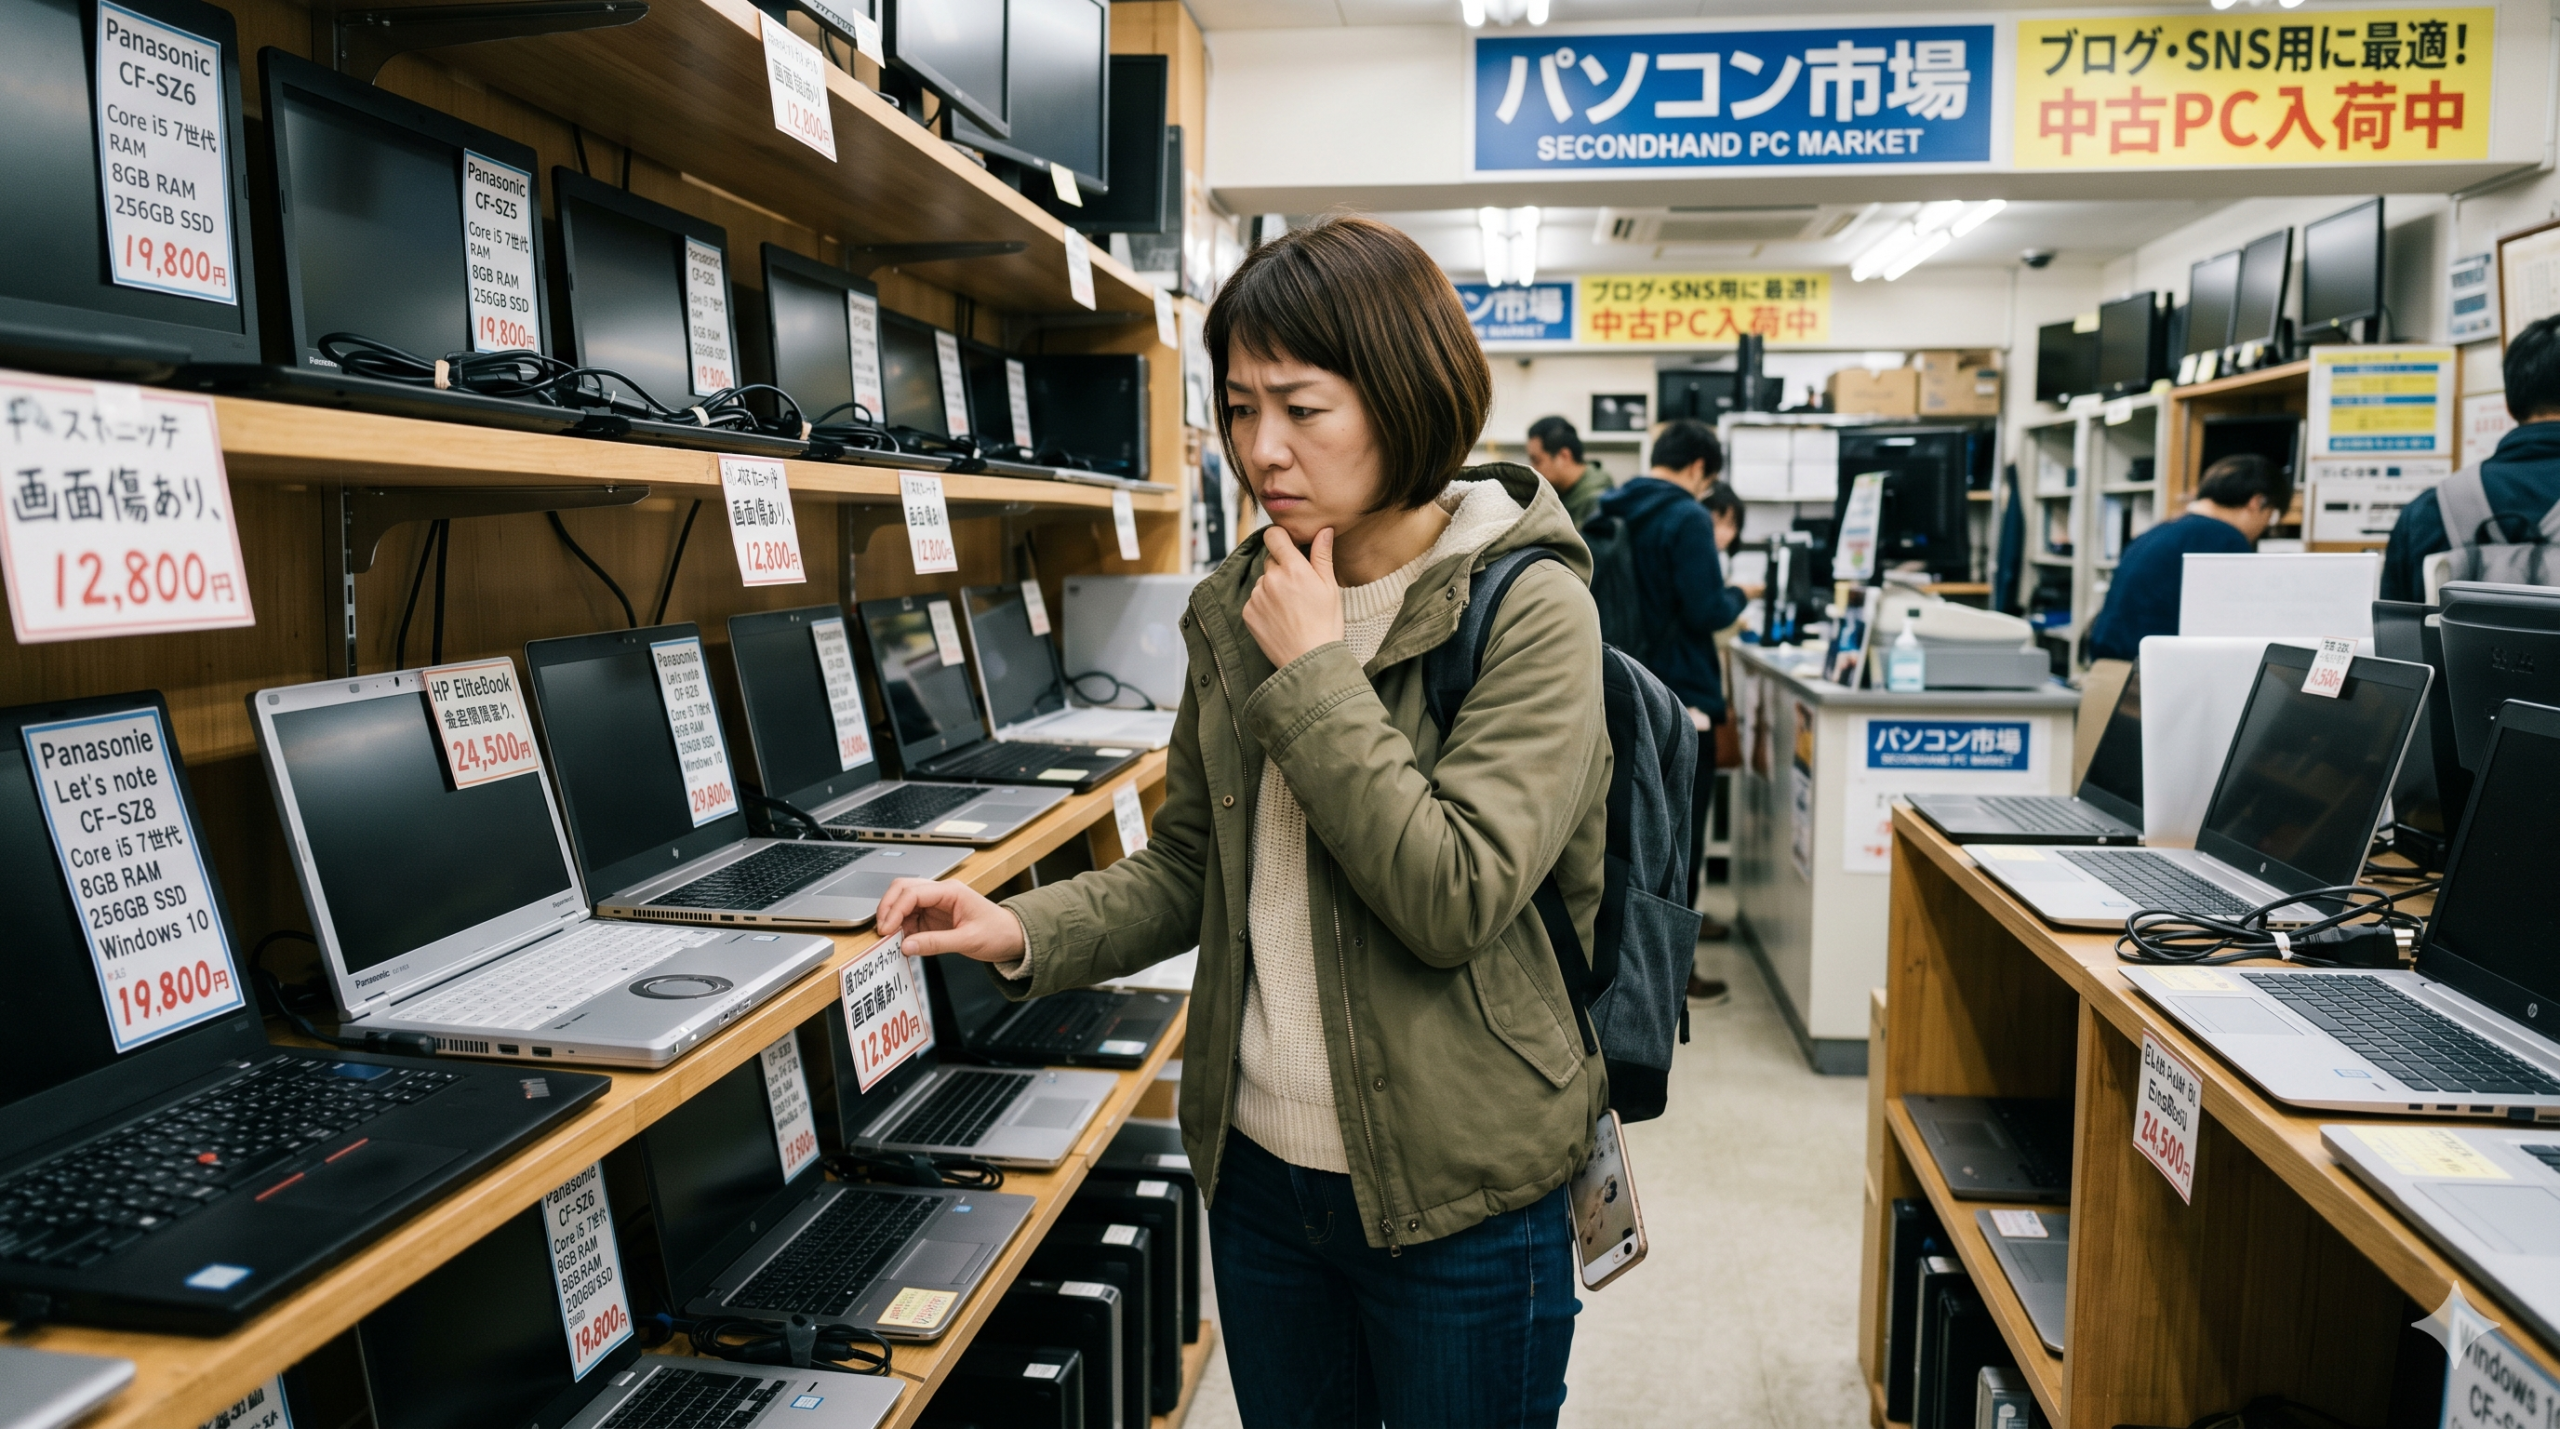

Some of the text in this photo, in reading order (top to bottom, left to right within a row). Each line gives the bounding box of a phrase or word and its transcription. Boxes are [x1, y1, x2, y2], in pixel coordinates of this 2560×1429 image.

[106, 17, 211, 77] Panasonic
[119, 61, 197, 106] CF-SZ6
[1495, 40, 1971, 125] パソコン市場
[107, 104, 217, 153] Core i5 7世代
[788, 99, 831, 148] 12,800円
[2039, 79, 2465, 156] 中古PC入荷中
[109, 133, 147, 158] RAM
[1537, 128, 1924, 161] SECONDHAND PC MARKET
[112, 163, 196, 200] 8GB RAM
[468, 161, 526, 198] Panasonic
[114, 195, 214, 234] 256GB SSD
[475, 192, 518, 220] CF-SZ5
[469, 221, 529, 254] Core i5 7世代
[470, 242, 491, 260] RAM
[125, 234, 227, 287] 19,800円
[472, 265, 519, 290] 8GB RAM
[473, 287, 529, 313] 256GB SSD
[479, 316, 535, 350] 19,800円
[1592, 306, 1818, 341] 中古PC入荷中
[746, 541, 800, 573] 12,800円
[57, 550, 235, 613] 12,800円
[431, 672, 512, 702] HP EliteBook
[690, 720, 705, 735] RAM
[1874, 726, 2022, 755] パソコン市場
[453, 731, 532, 772] 24,500円
[714, 751, 723, 764] 10
[54, 765, 158, 803] Let's note
[80, 798, 156, 834] CF-SZ8
[70, 824, 183, 868] Core i5 7世代
[80, 860, 162, 899] 8GB RAM
[90, 885, 187, 930] 256GB SSD
[98, 908, 209, 961] Windows 10
[119, 959, 230, 1027] 19,800円
[861, 1009, 921, 1073] 12,800円
[558, 1189, 595, 1227] CF-SZ6
[554, 1232, 576, 1256] Core
[578, 1235, 598, 1262] RAM
[581, 1253, 602, 1279] RAM
